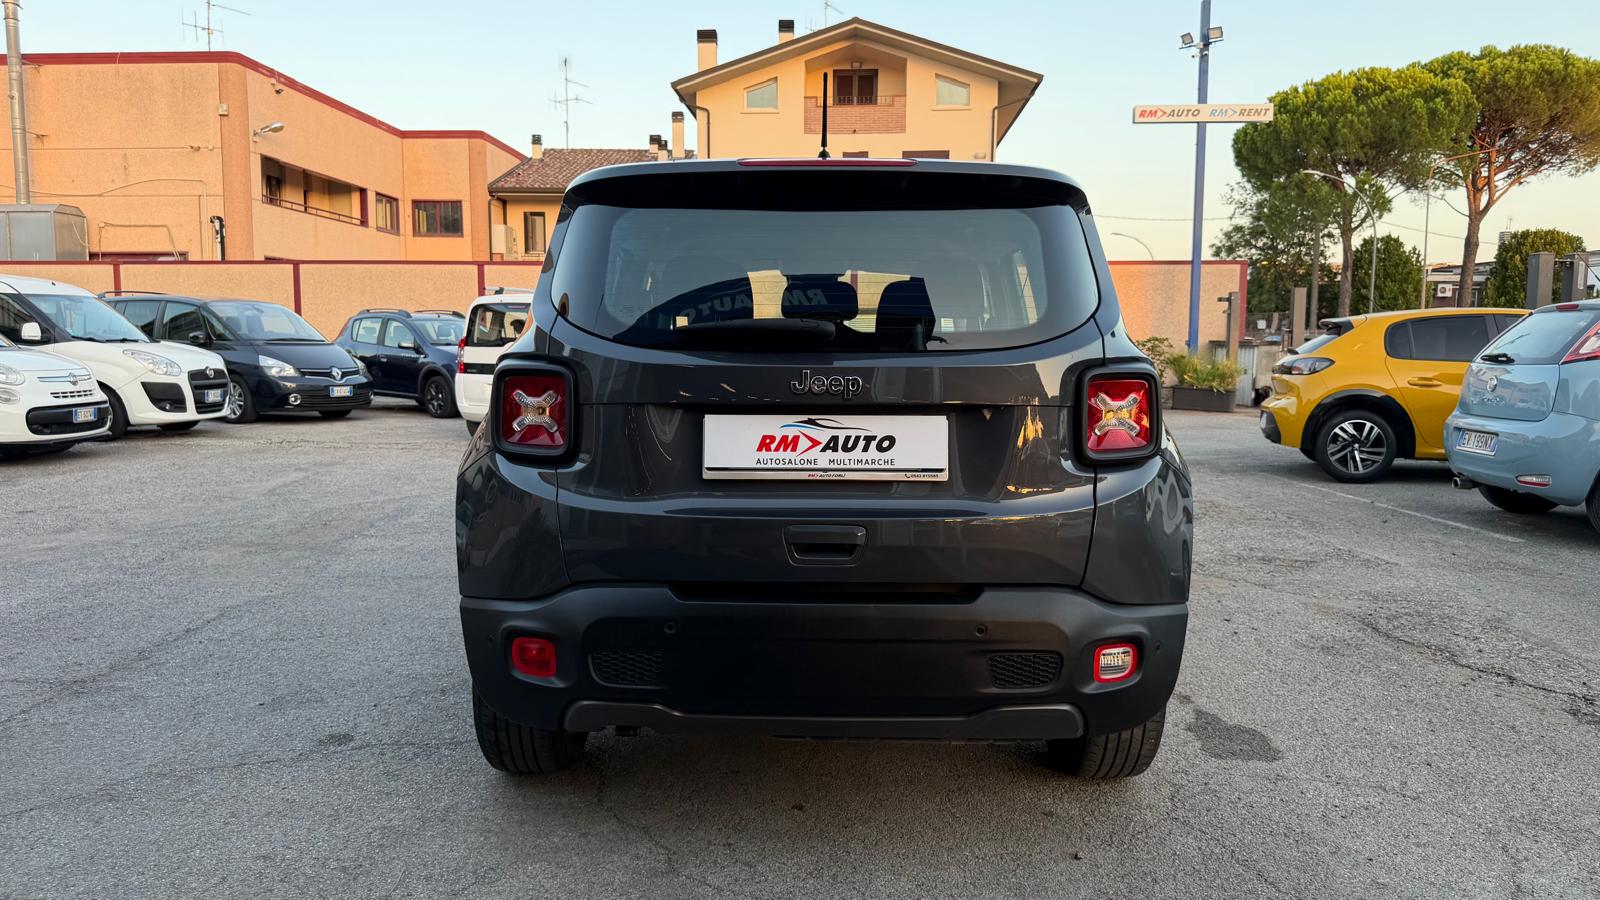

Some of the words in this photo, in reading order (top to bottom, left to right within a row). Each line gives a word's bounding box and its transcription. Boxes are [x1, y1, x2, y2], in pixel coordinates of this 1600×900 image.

[790, 369, 863, 399] Jeep
[819, 434, 897, 453] AUTO
[755, 458, 819, 466] AUTOSALONE
[828, 458, 896, 466] MULTIMARCHE
